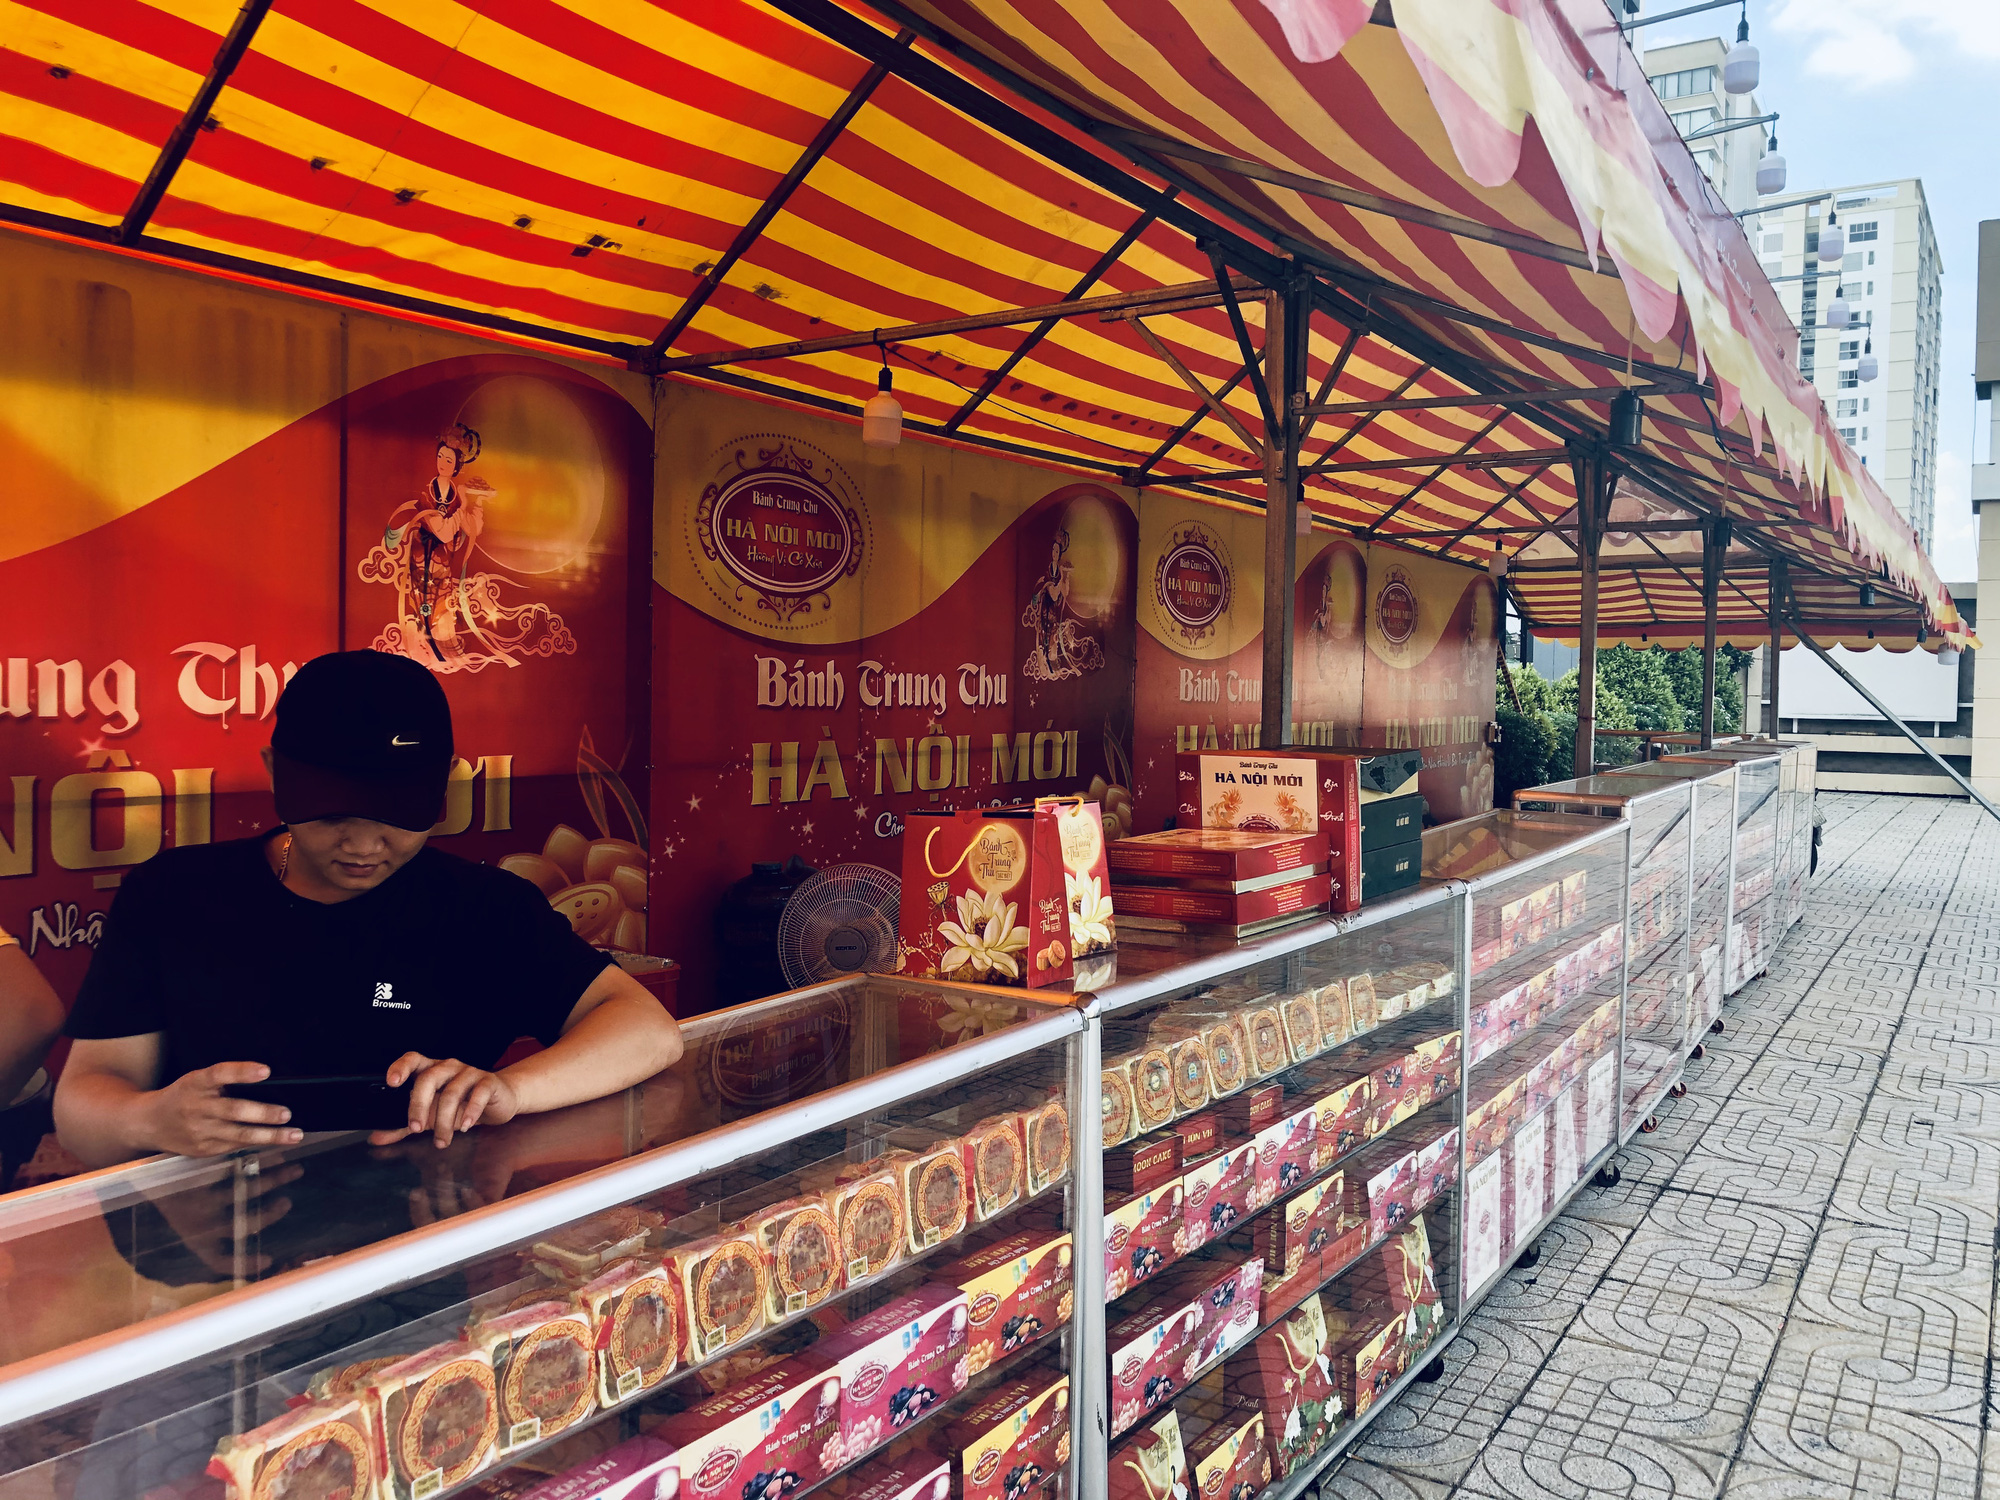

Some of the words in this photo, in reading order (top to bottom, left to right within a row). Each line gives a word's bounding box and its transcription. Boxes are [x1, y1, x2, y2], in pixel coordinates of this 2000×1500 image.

[752, 490, 774, 507] Bánh
[776, 494, 800, 514] Trung
[803, 499, 818, 514] Thu
[727, 517, 757, 540] HÀ
[765, 523, 799, 547] NỘI
[806, 529, 842, 551] MỚI
[0, 657, 140, 734] ung
[754, 653, 845, 711] Bánh
[857, 660, 946, 716] Trung
[956, 663, 1007, 713] Thu
[1178, 666, 1220, 704] Bánh
[1226, 669, 1263, 706] Trun
[1176, 714, 1219, 753] HÀ
[751, 725, 850, 806] HÀ
[874, 723, 971, 802] NỘI
[991, 719, 1079, 785] MỚI
[1215, 770, 1236, 784] HÀ
[1241, 772, 1268, 787] NỘI
[1273, 773, 1303, 787] MỚI
[980, 838, 1007, 855] Bánh
[987, 852, 1012, 869] Trung
[372, 998, 412, 1010] Browmio
[1152, 1149, 1172, 1165] CAKE
[907, 1358, 921, 1371] Bánh
[921, 1350, 935, 1363] Trung
[936, 1344, 945, 1355] Thu
[765, 1440, 781, 1454] Bánh
[782, 1430, 799, 1445] Trung
[800, 1421, 811, 1434] Thu
